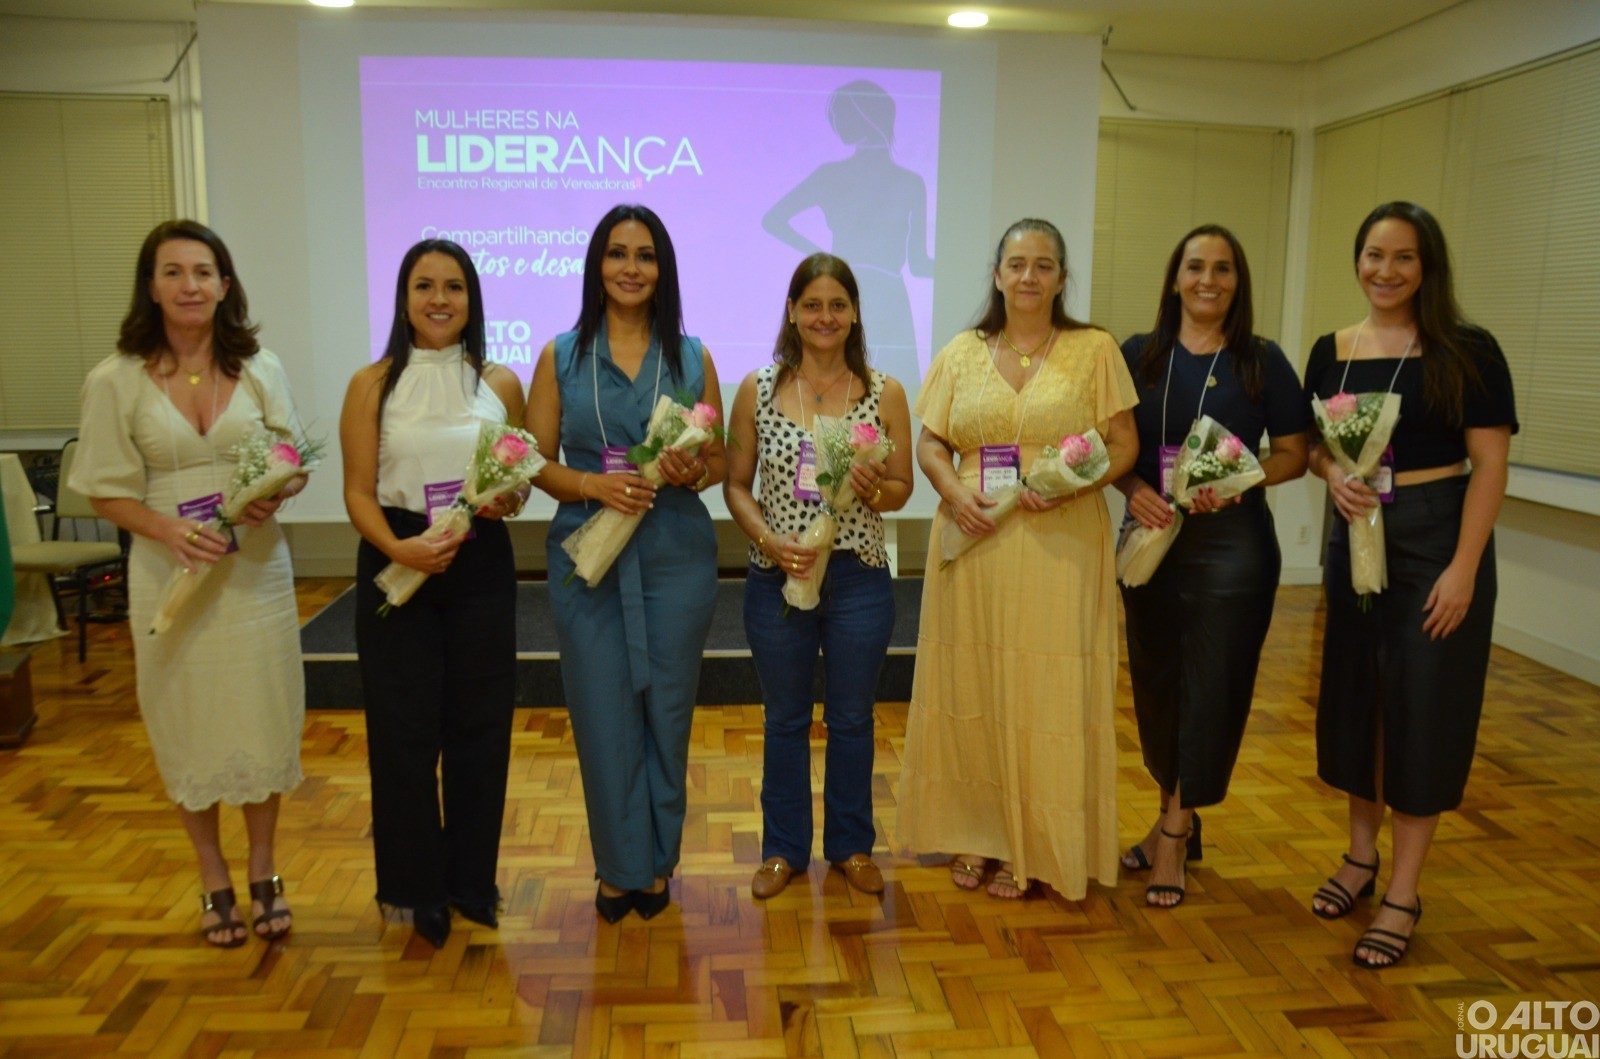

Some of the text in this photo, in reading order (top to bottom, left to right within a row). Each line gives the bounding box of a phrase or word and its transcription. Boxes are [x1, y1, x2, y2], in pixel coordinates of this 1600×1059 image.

[415, 109, 579, 130] MULHERES NA
[416, 133, 703, 182] LIDERANÇA
[417, 177, 637, 192] Encontro Regional de Vereadoras
[421, 225, 590, 247] Compartilhando
[514, 256, 529, 276] e
[531, 248, 585, 277] desa
[484, 320, 531, 343] LTO
